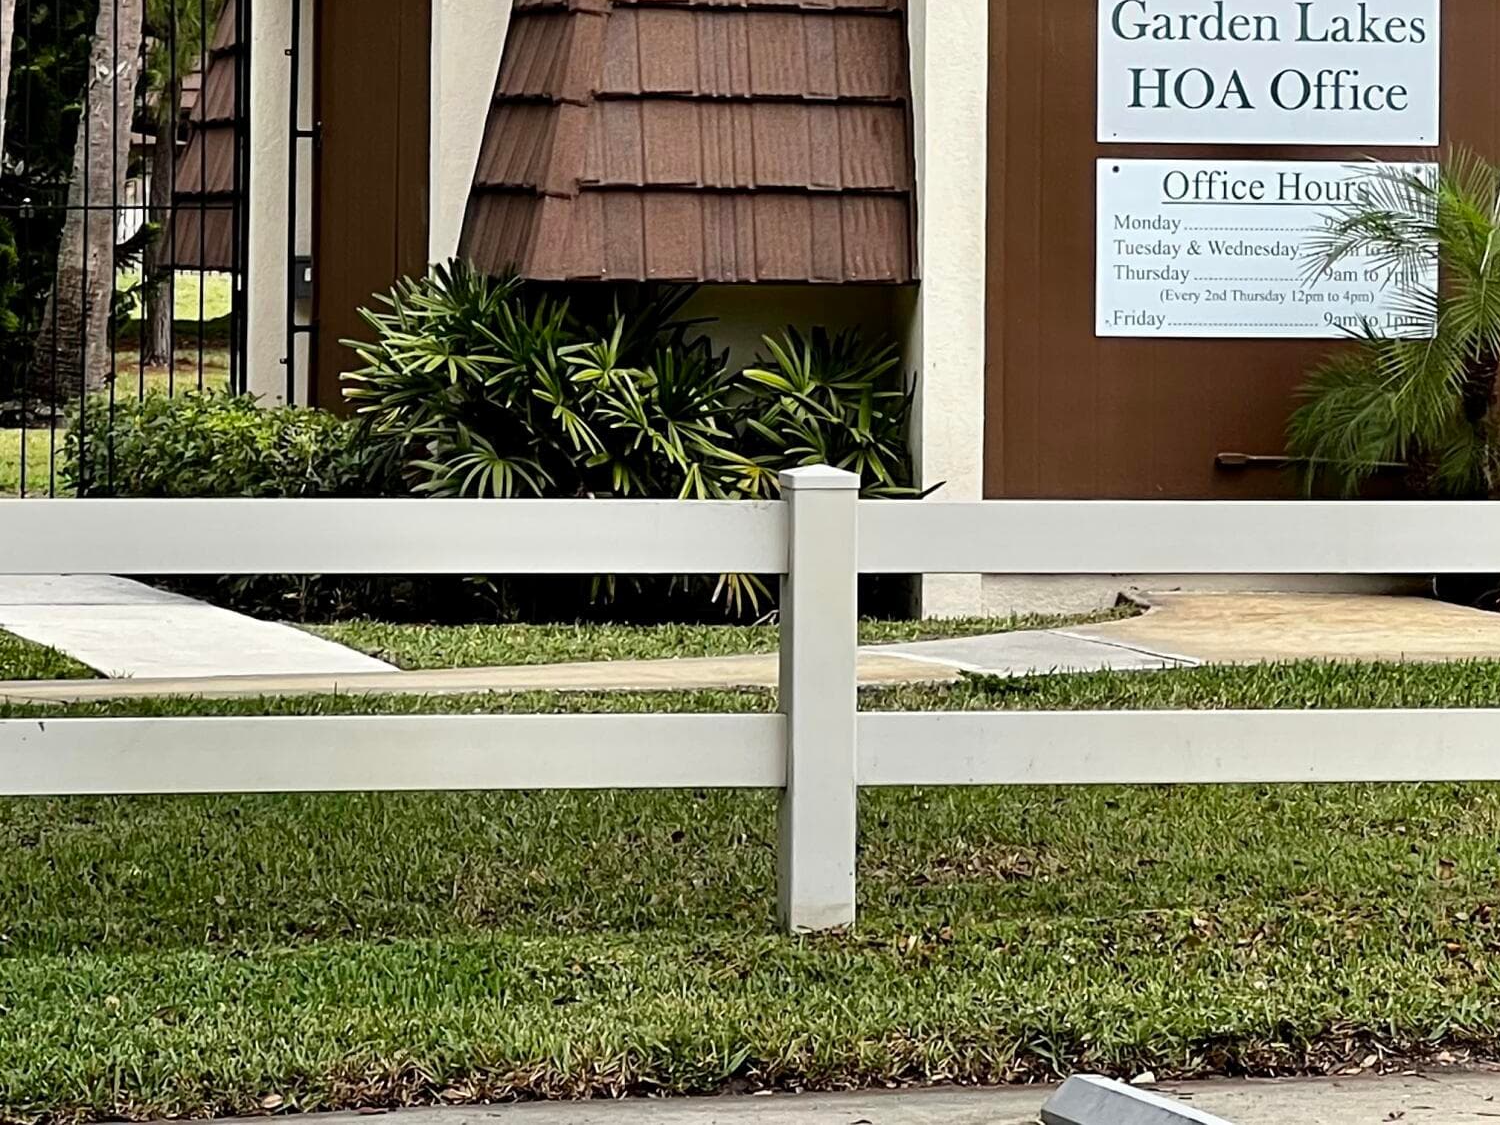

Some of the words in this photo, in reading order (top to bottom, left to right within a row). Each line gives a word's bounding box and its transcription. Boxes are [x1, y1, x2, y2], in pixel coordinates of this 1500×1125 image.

[1295, 1, 1426, 44] Lakes
[1127, 68, 1255, 110] HOA
[1270, 69, 1409, 111] Office
[1162, 170, 1265, 201] Office
[1277, 172, 1370, 202] Hours
[1113, 215, 1182, 235] Monday
[1113, 240, 1181, 260] Tuesday
[1186, 241, 1203, 257] &
[1208, 241, 1301, 261] Wednesday
[1113, 265, 1191, 285] Thursday
[1323, 267, 1358, 282] 9am
[1364, 269, 1379, 282] to
[1159, 289, 1201, 304] (Every
[1204, 289, 1228, 302] 2nd
[1231, 289, 1286, 305] Thursday
[1291, 290, 1325, 305] 12pm
[1327, 292, 1340, 303] to
[1343, 290, 1375, 305] 4pm)
[1113, 311, 1167, 331] Friday
[1323, 312, 1358, 327] 9am
